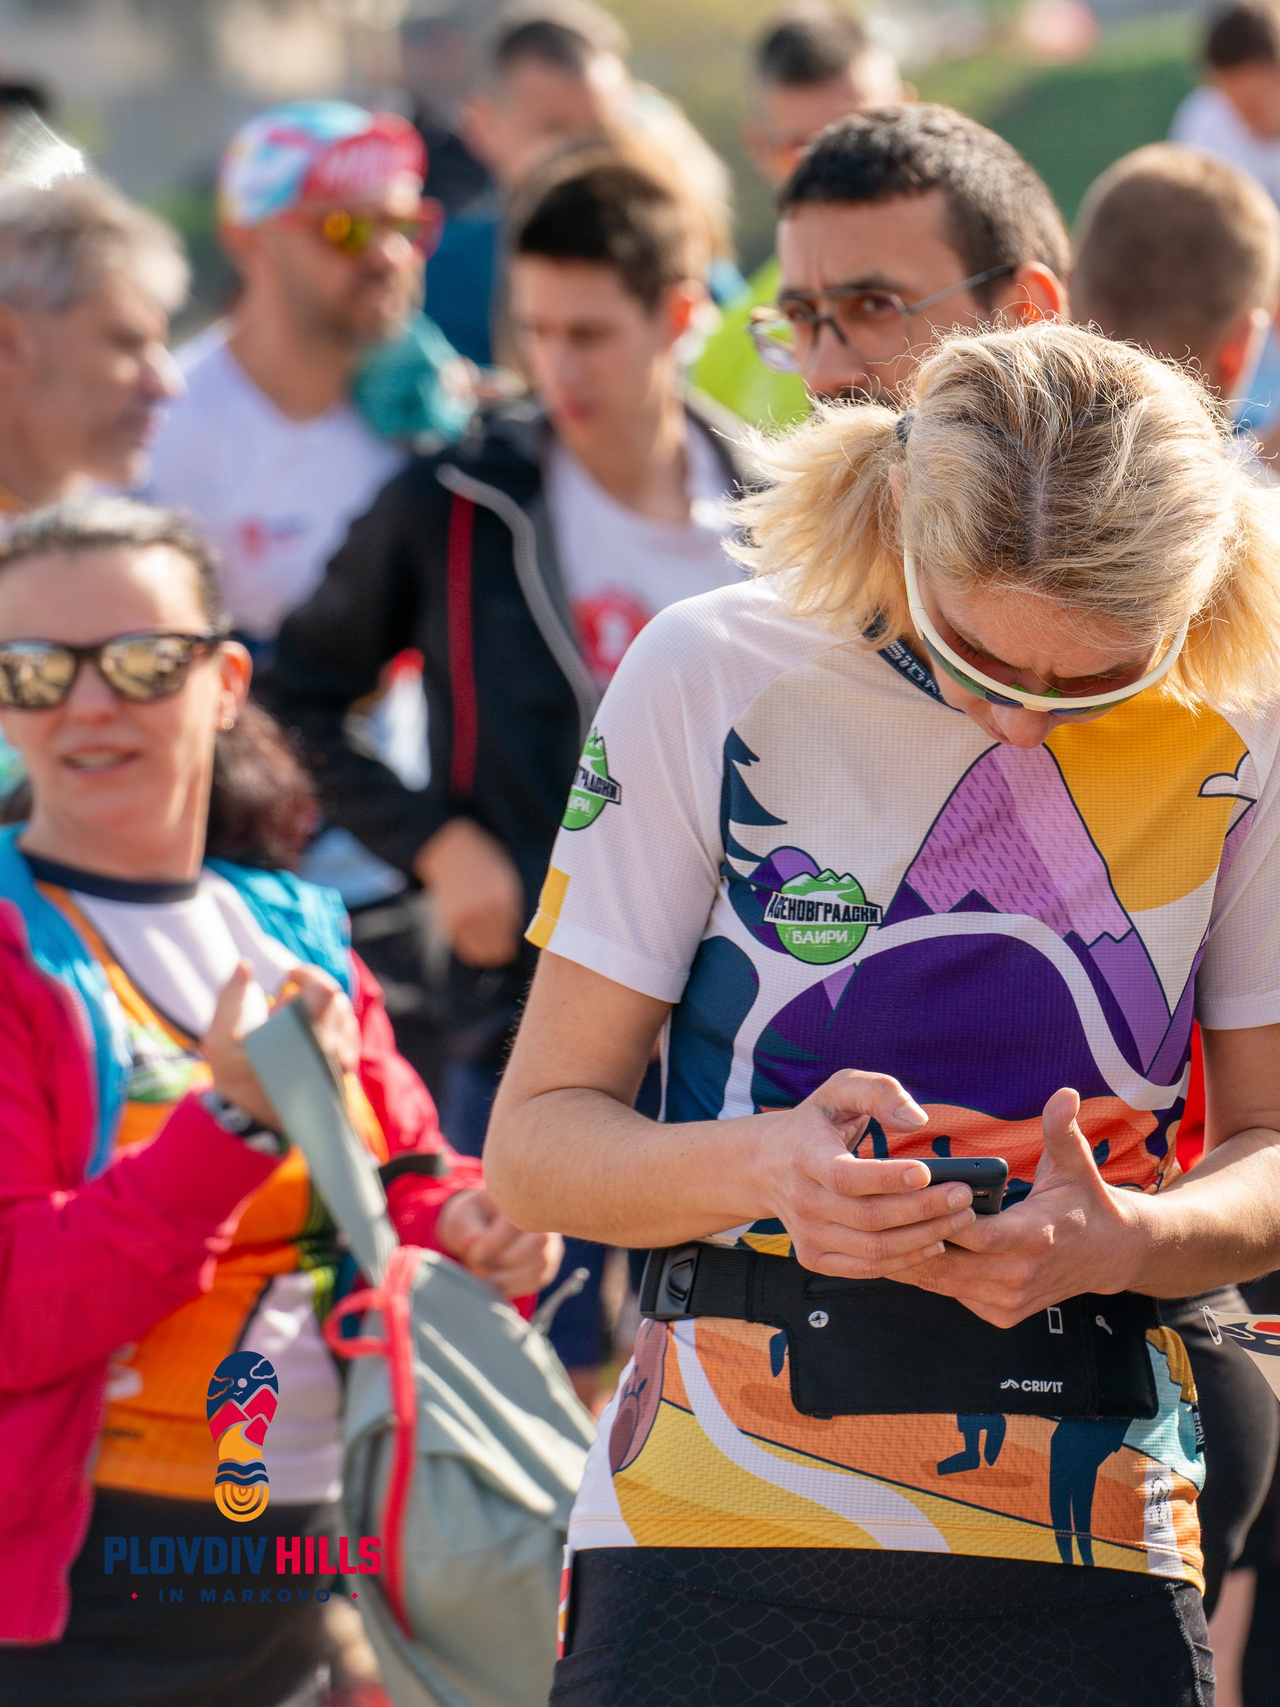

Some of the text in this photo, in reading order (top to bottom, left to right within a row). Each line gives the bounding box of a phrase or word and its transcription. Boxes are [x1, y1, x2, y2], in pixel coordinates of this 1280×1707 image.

[766, 893, 879, 922] АСЕНОВГРАДСКИ
[791, 929, 848, 944] БАИРИ
[1021, 1380, 1063, 1394] CRIVIT
